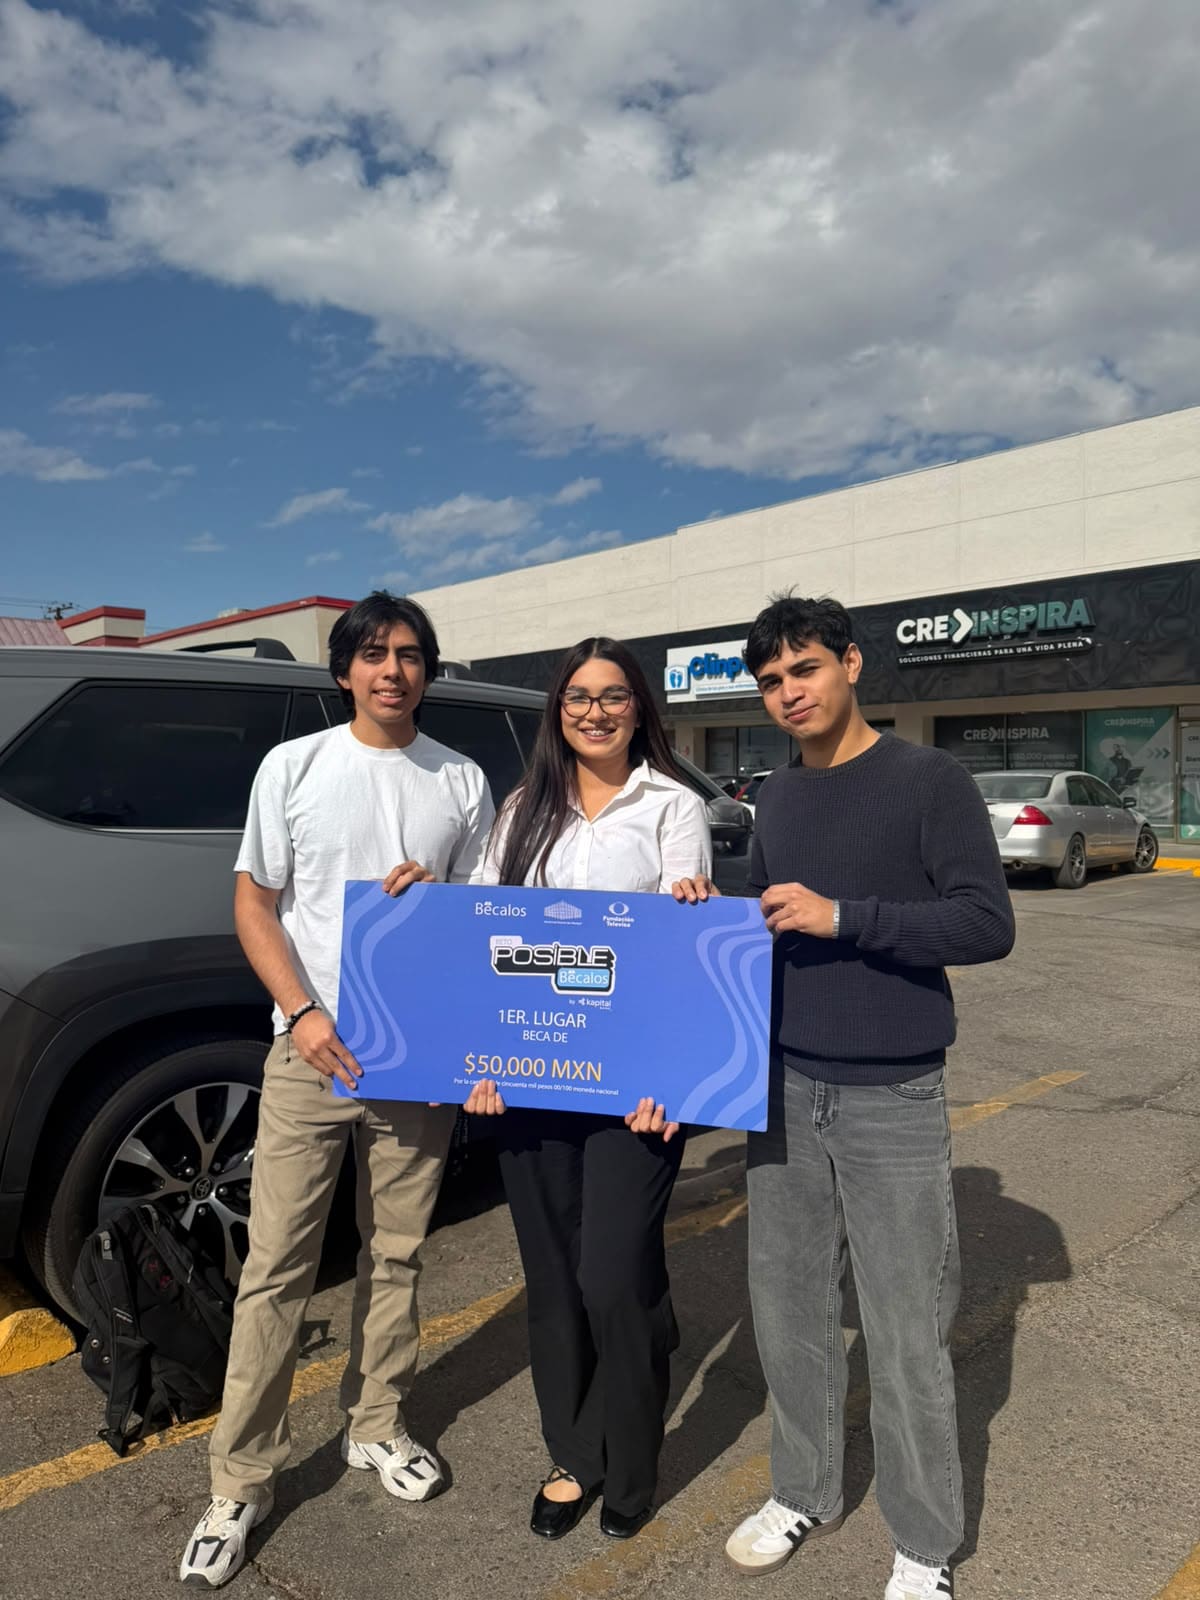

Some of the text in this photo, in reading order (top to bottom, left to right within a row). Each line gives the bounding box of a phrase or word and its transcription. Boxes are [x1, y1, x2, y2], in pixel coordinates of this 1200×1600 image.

[898, 640, 1084, 664] SOLUCIONES FINANCIERAS PARA UNA VIDA PLENA
[602, 915, 635, 923] Fundación
[494, 944, 609, 967] POSIBLE
[586, 999, 612, 1007] kapital
[498, 1009, 587, 1028] 1ER. LUGAR
[522, 1030, 568, 1043] BECA DE
[464, 1052, 602, 1082] $50,000 MXN
[501, 1080, 527, 1088] cincuenta
[537, 1083, 553, 1091] pesos
[553, 1083, 572, 1091] 00/100
[596, 1088, 619, 1096] nacional
